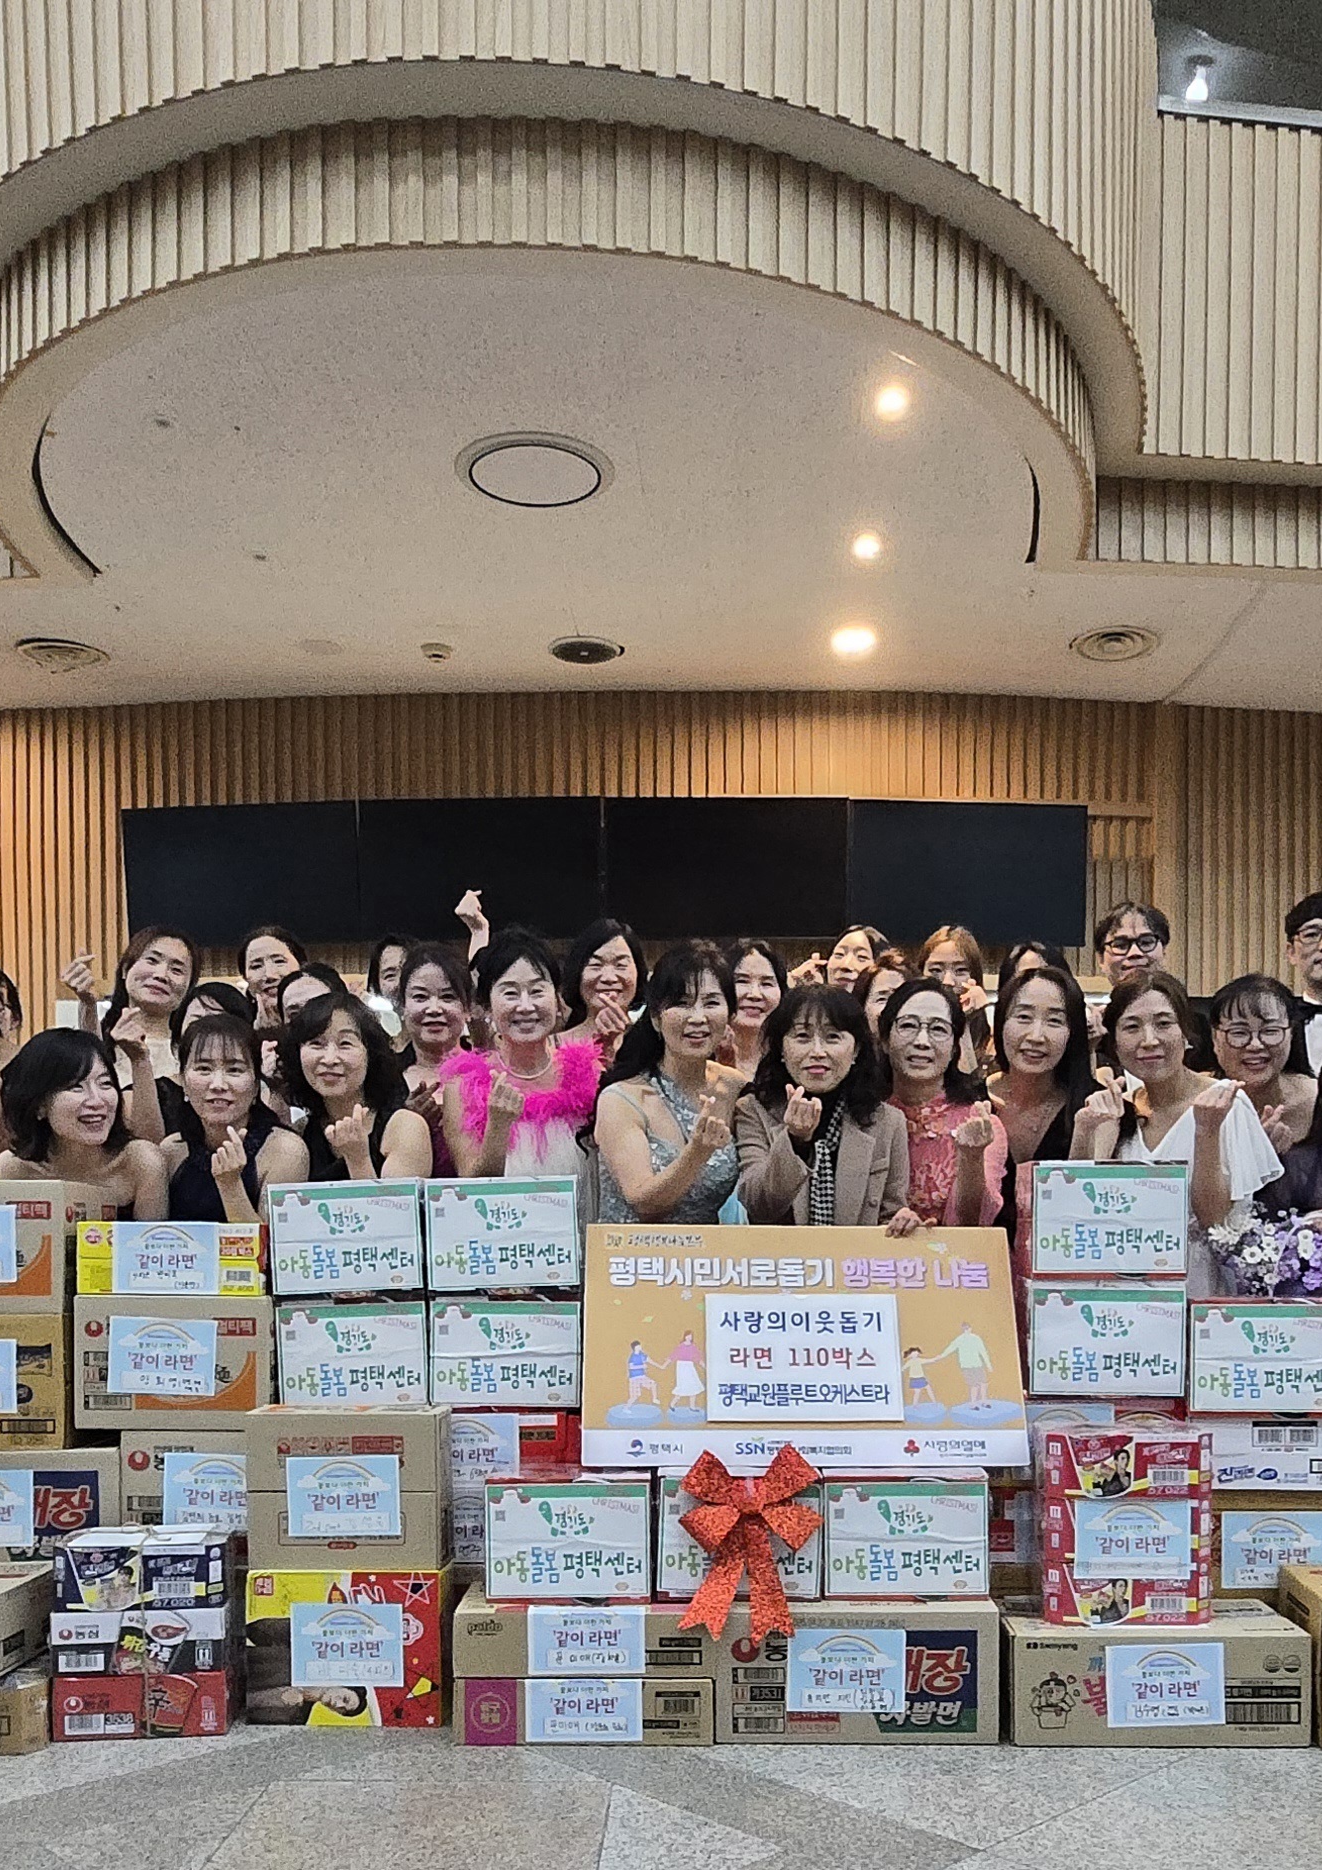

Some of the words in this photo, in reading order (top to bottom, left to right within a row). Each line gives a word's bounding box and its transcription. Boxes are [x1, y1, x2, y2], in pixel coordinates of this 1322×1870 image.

[608, 1256, 834, 1288] 평택시민서로돕기
[842, 1258, 926, 1289] 행복한
[935, 1258, 990, 1289] 나눔
[720, 1310, 884, 1334] 사랑의이웃돕기
[729, 1347, 773, 1369] 라면
[789, 1347, 876, 1368] 110박스
[718, 1383, 890, 1406] 평택교원플루트오케스트라
[649, 1442, 684, 1455] 평택시
[735, 1441, 767, 1455] SSN
[75, 1628, 100, 1639] 농심
